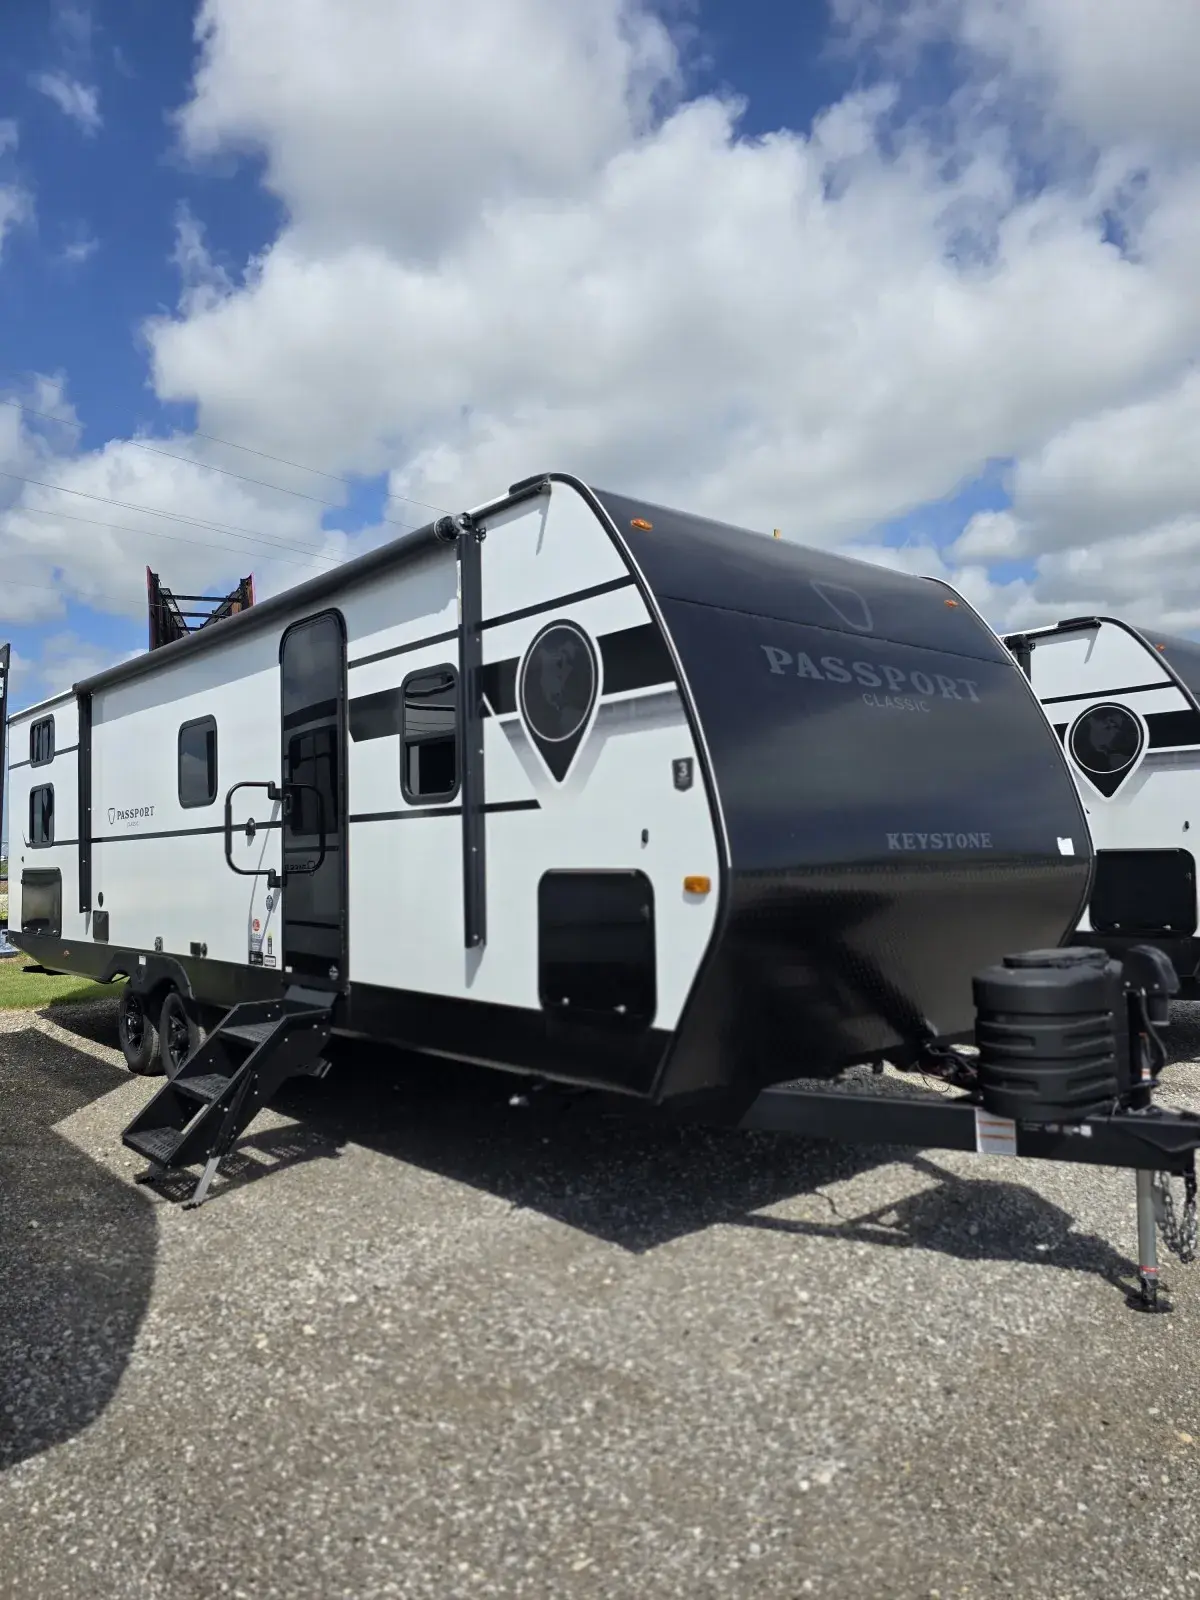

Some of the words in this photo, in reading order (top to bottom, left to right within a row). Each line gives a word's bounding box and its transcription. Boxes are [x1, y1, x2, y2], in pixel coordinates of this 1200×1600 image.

[760, 644, 981, 703] PASSPORT
[862, 693, 931, 713] CLASSIC
[678, 761, 688, 777] 3
[117, 805, 155, 820] PASSPORT
[885, 832, 993, 850] KEYSTONE
